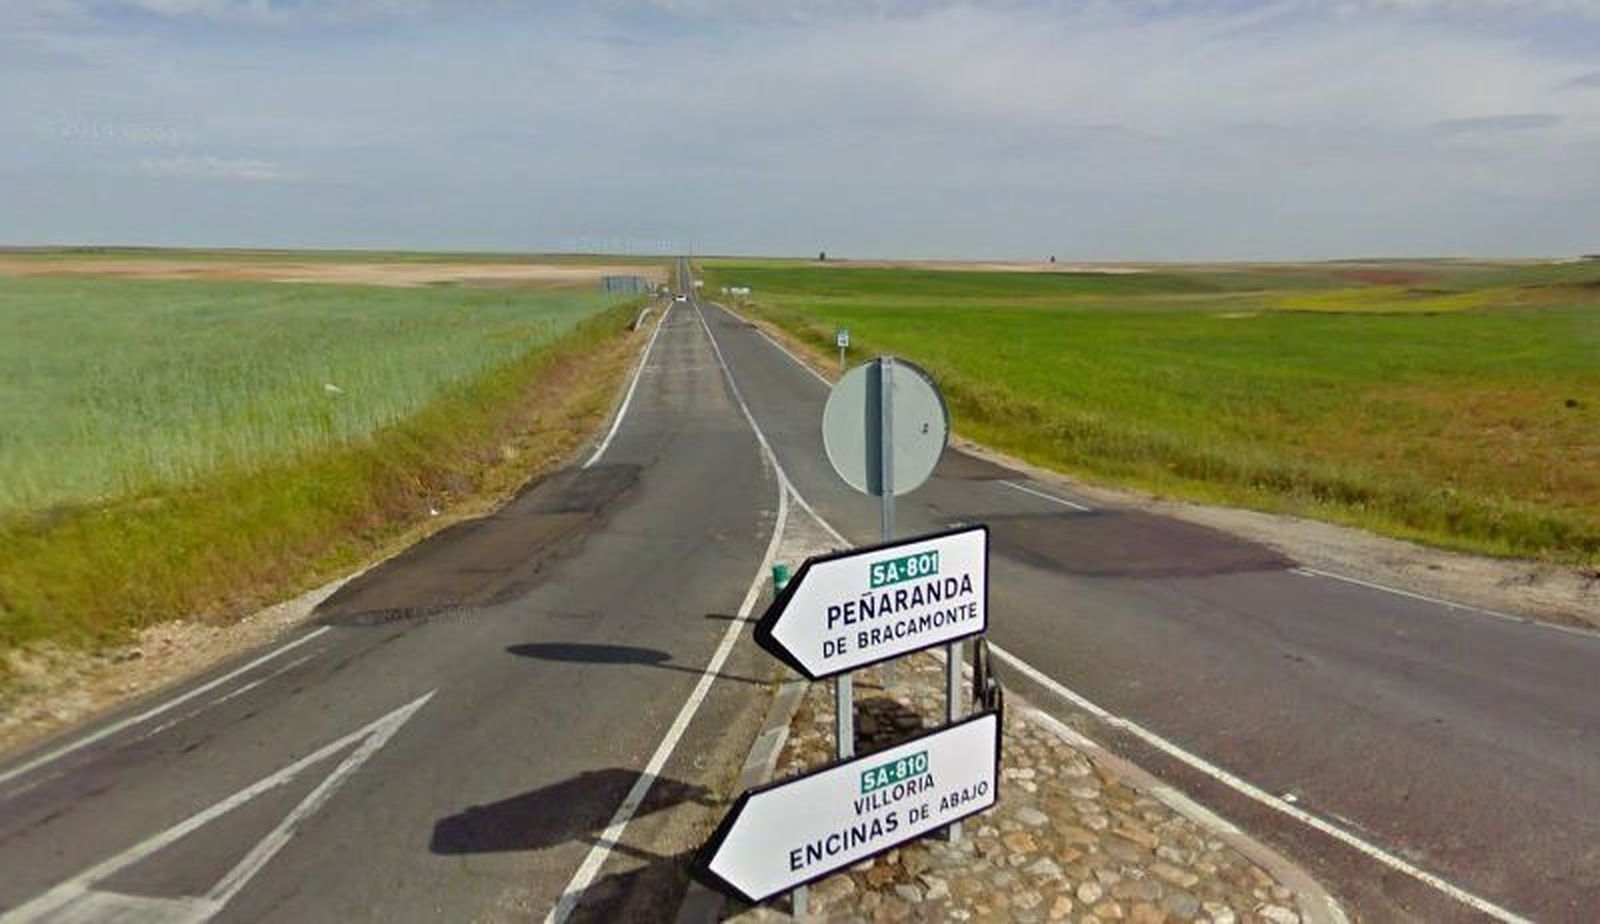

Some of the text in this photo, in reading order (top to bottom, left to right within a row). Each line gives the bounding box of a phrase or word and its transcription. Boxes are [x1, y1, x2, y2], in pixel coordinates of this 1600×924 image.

[873, 553, 937, 585] SA-801
[827, 573, 974, 630] PEÑARANDA
[822, 602, 978, 659] DE BRACAMONTE
[854, 773, 935, 816] VILLORIA
[863, 753, 926, 791] SA-810
[789, 781, 989, 872] ENCINAS DE ABAJO
